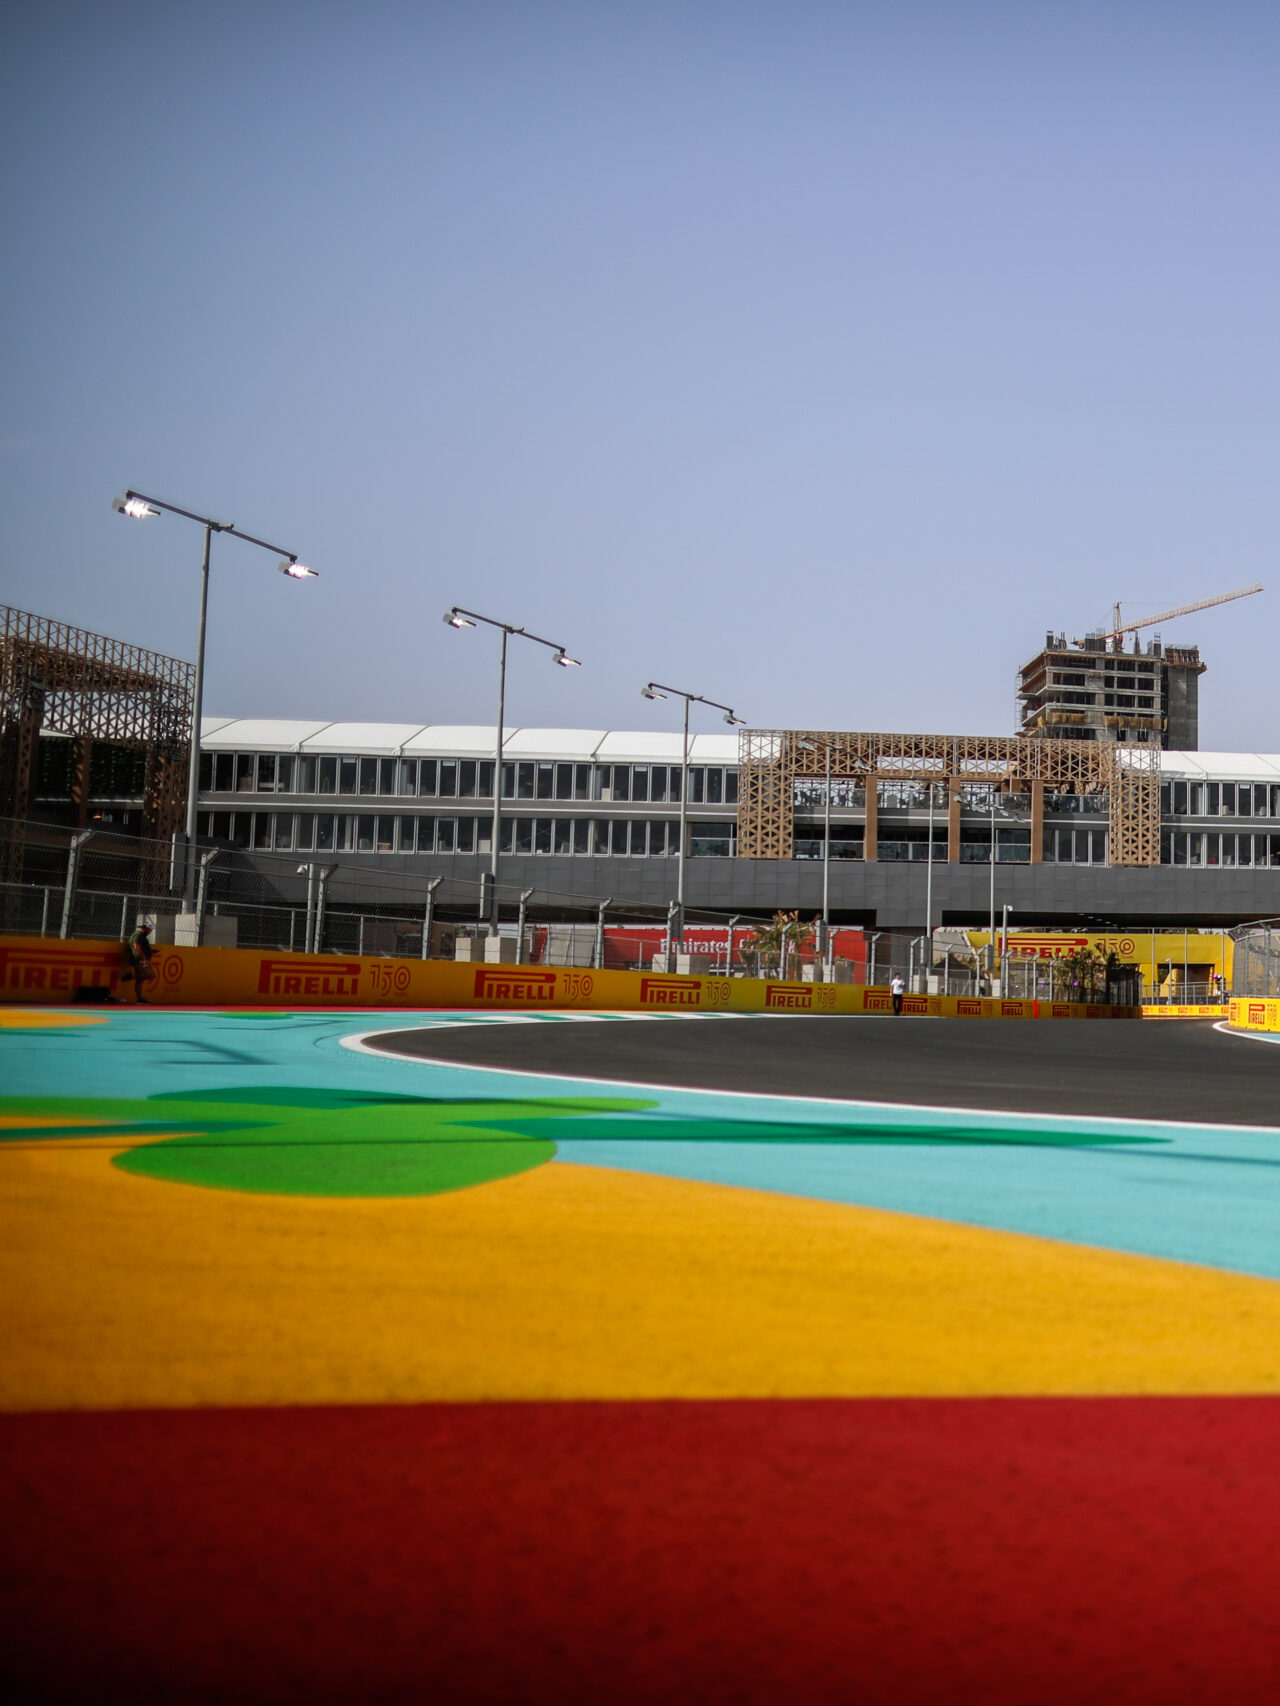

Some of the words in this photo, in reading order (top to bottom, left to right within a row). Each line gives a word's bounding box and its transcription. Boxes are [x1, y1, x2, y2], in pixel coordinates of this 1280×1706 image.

[258, 960, 361, 996] PIRELLI
[370, 965, 411, 997] 150
[473, 970, 557, 1001] PIRELLI
[563, 974, 594, 1002] 150
[640, 978, 702, 1005] PIRELLI
[706, 981, 731, 1006] 150
[765, 985, 813, 1008] PIRELLI
[900, 997, 928, 1013] PIRELLI
[957, 1000, 981, 1015] PIRELLI
[1249, 1004, 1265, 1025] PIRELLI
